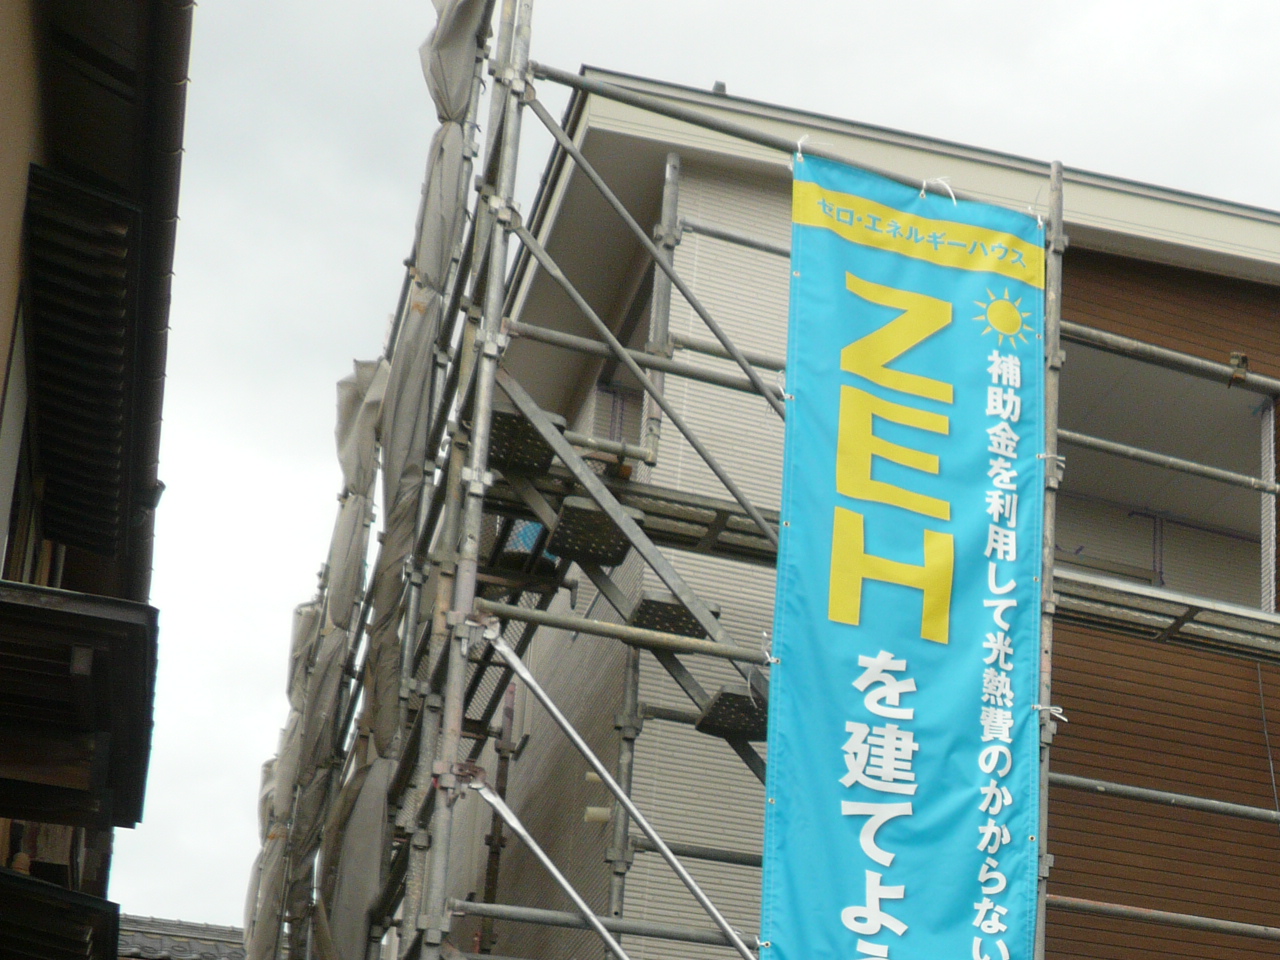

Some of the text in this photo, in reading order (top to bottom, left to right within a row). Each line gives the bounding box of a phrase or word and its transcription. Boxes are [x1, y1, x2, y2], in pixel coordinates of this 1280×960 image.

[817, 198, 1027, 268] ゼロ・エネルギーハウス
